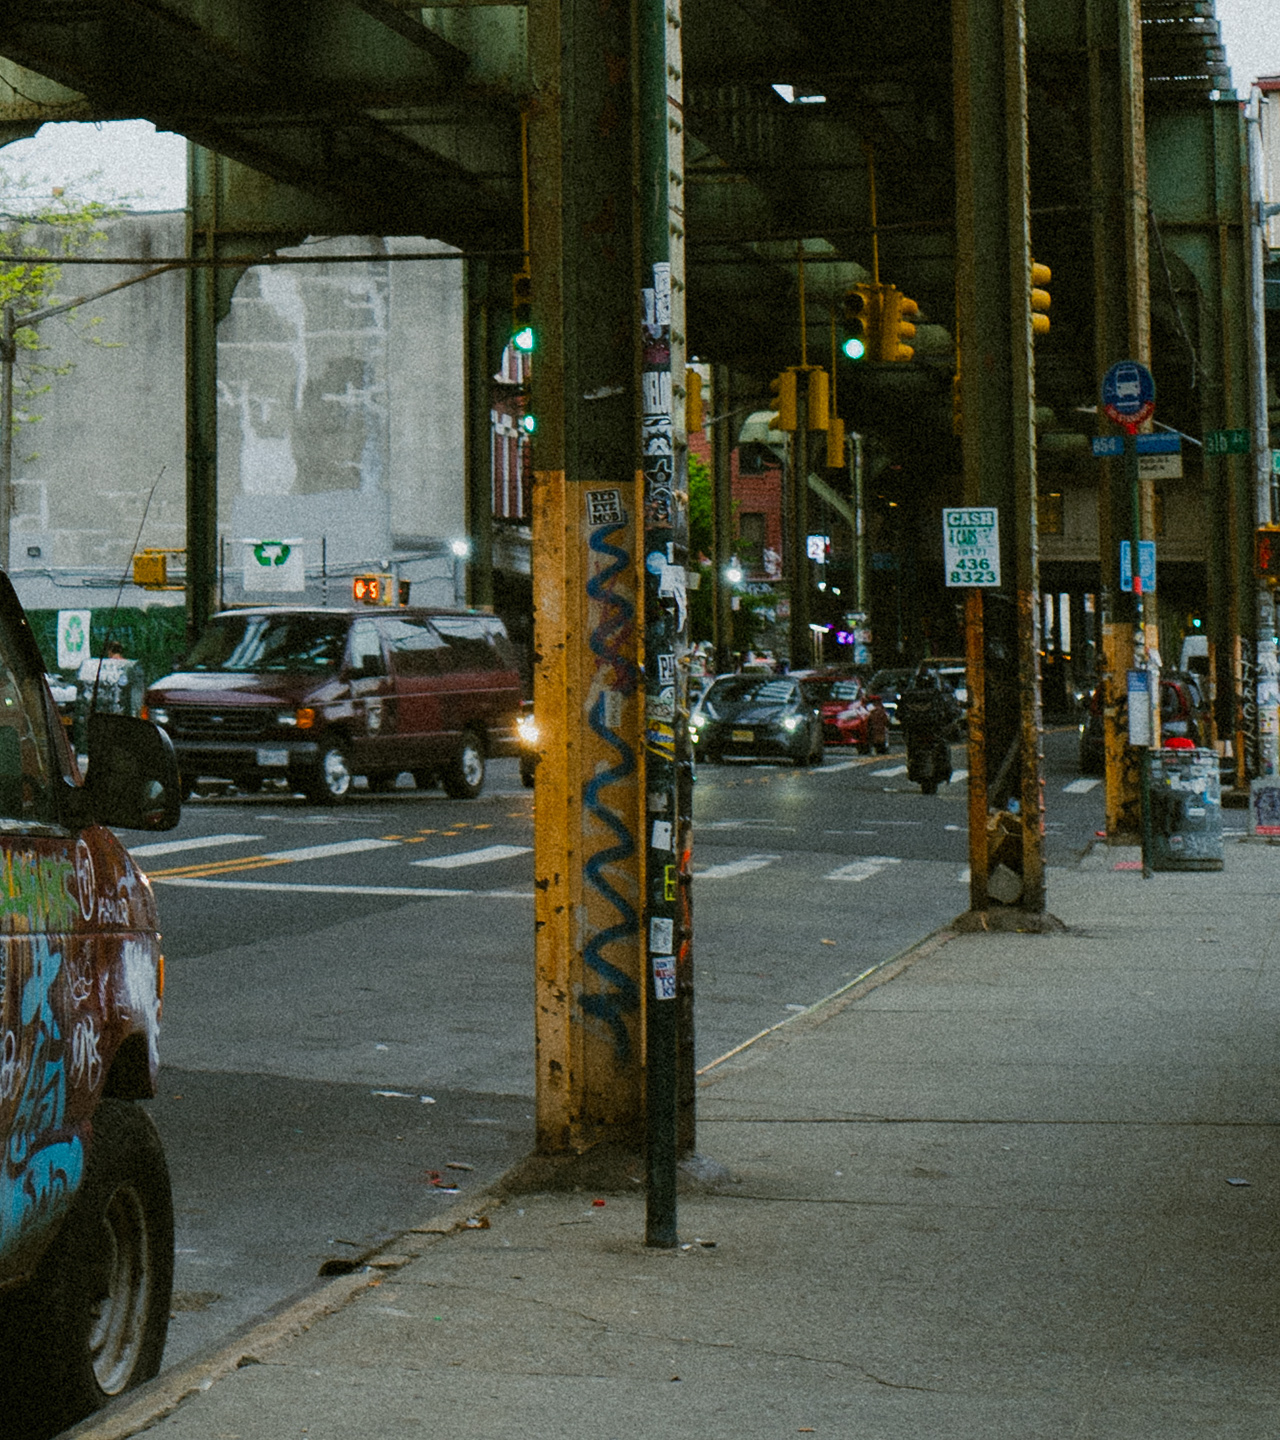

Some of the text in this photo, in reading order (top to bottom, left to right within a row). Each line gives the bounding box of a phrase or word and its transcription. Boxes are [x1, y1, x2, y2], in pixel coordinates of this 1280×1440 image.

[591, 491, 616, 502] RED
[592, 502, 617, 513] EYE
[948, 512, 993, 526] CASH
[955, 558, 990, 571] 436
[950, 570, 996, 584] 8323
